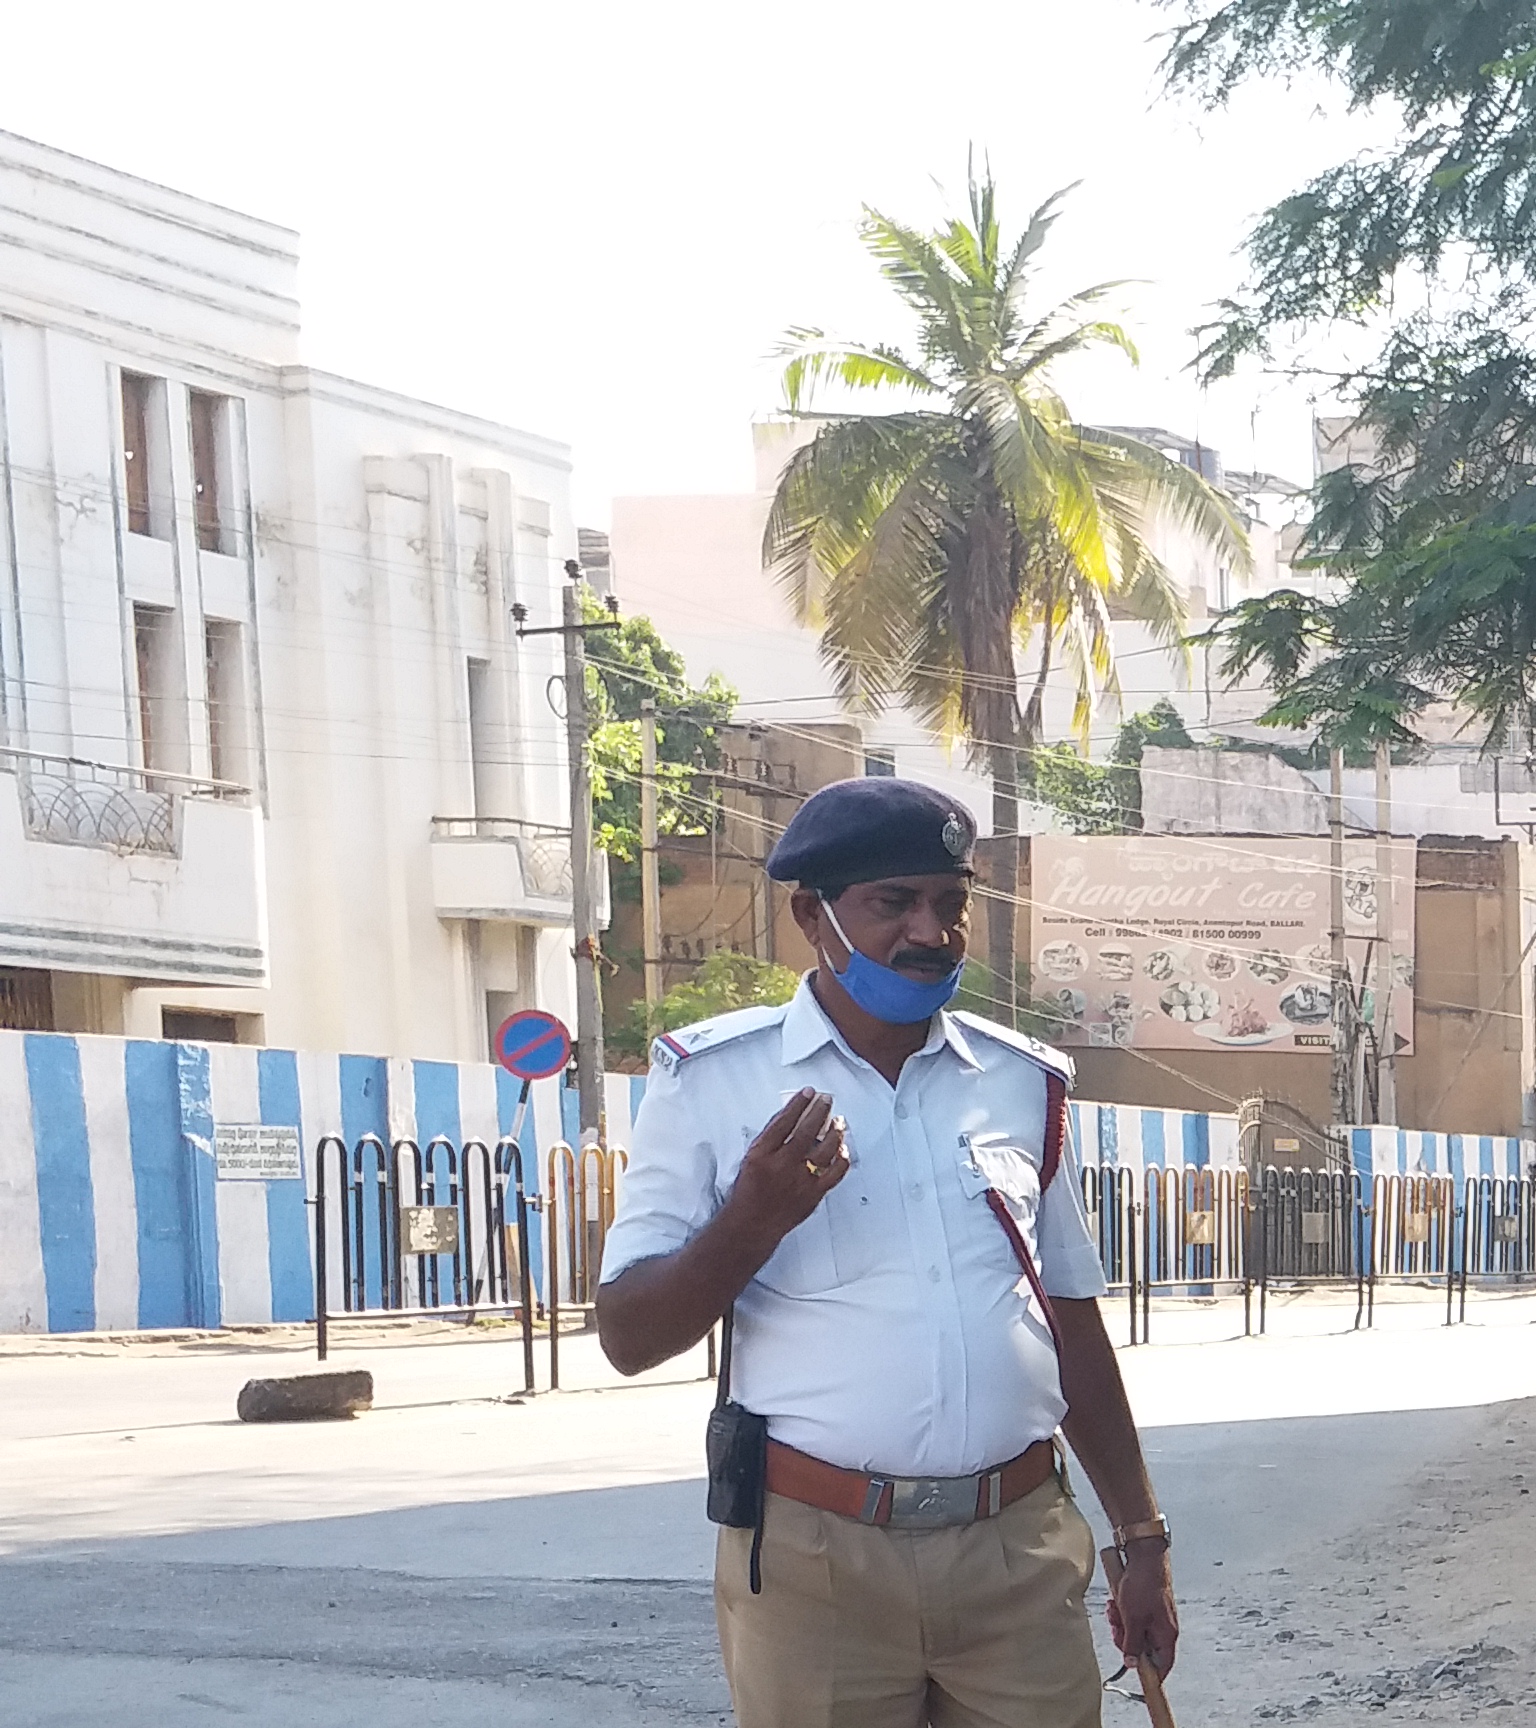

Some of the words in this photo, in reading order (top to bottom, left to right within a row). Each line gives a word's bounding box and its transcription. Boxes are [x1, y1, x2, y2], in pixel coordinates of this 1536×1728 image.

[1048, 877, 1223, 918] Hangout
[1237, 881, 1317, 911] Cafe
[1085, 928, 1105, 938] Cell
[1192, 930, 1225, 939] 81500
[1228, 930, 1261, 939] 00999
[1300, 1036, 1330, 1045] VISIT
